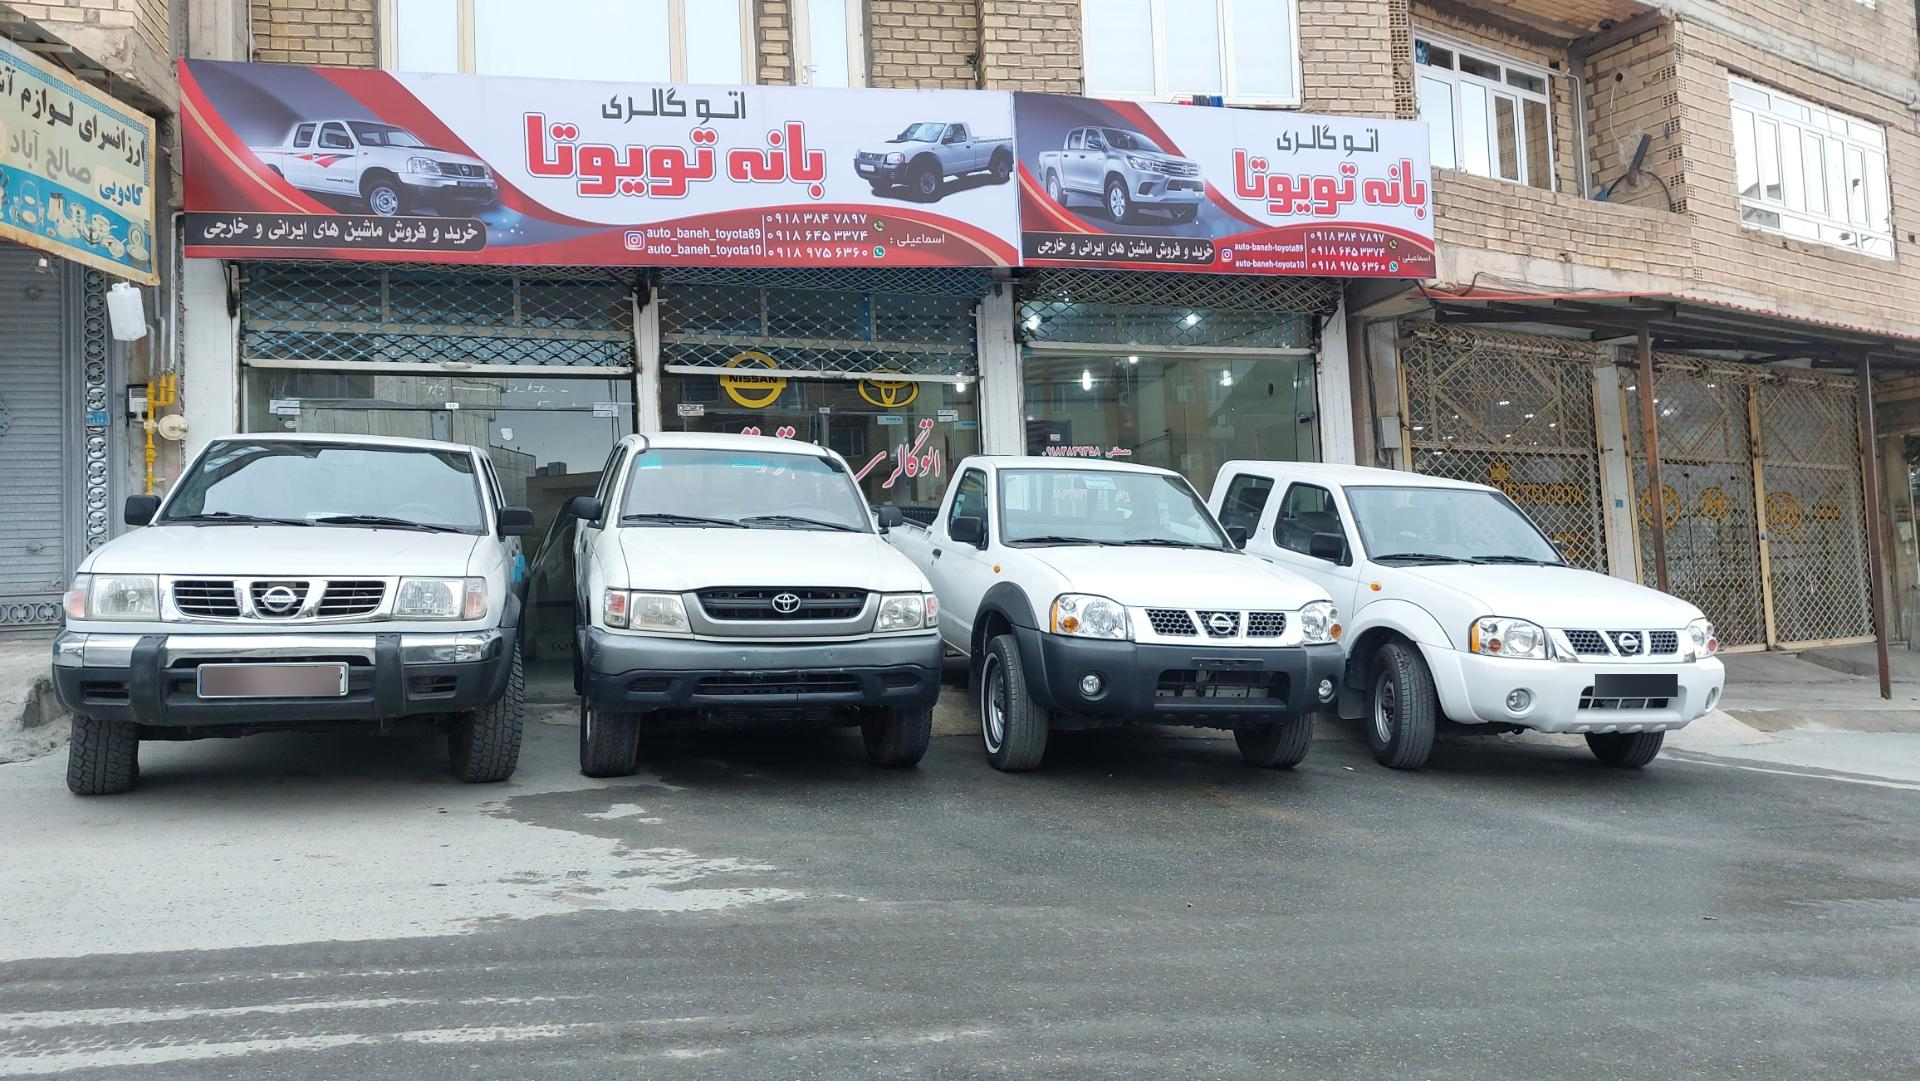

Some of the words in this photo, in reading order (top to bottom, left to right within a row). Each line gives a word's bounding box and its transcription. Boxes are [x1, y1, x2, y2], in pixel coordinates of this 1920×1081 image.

[21, 87, 74, 126] لوازم
[601, 86, 686, 124] گالری
[696, 90, 746, 125] اتو
[10, 129, 40, 170] آباد
[1277, 124, 1337, 155] گالری
[1343, 128, 1379, 157] اتو
[46, 145, 92, 185] صالح
[523, 112, 719, 199] تویوتا
[726, 120, 826, 199] بانه
[1232, 147, 1358, 217] تویوتا
[1363, 158, 1427, 219] بانه
[203, 218, 248, 240] خارجی
[255, 225, 263, 240] و
[268, 219, 307, 241] ایرانی
[313, 220, 339, 240] های
[344, 219, 383, 242] ماشین
[388, 219, 426, 242] فروش
[431, 227, 439, 243] و
[444, 221, 478, 244] خرید
[647, 227, 761, 243] auto_baneh_toyota89
[896, 233, 945, 247] اسماعیلی
[647, 243, 762, 259] auto_baneh_toyota10
[1037, 238, 1066, 255] خارجی
[1070, 243, 1076, 255] و
[1079, 240, 1104, 256] ایرانی
[1107, 243, 1125, 255] های
[1128, 240, 1153, 258] ماشین
[1155, 241, 1180, 259] فروش
[1183, 247, 1189, 259] و
[1192, 244, 1214, 260] خرید
[728, 375, 778, 383] NISSAN
